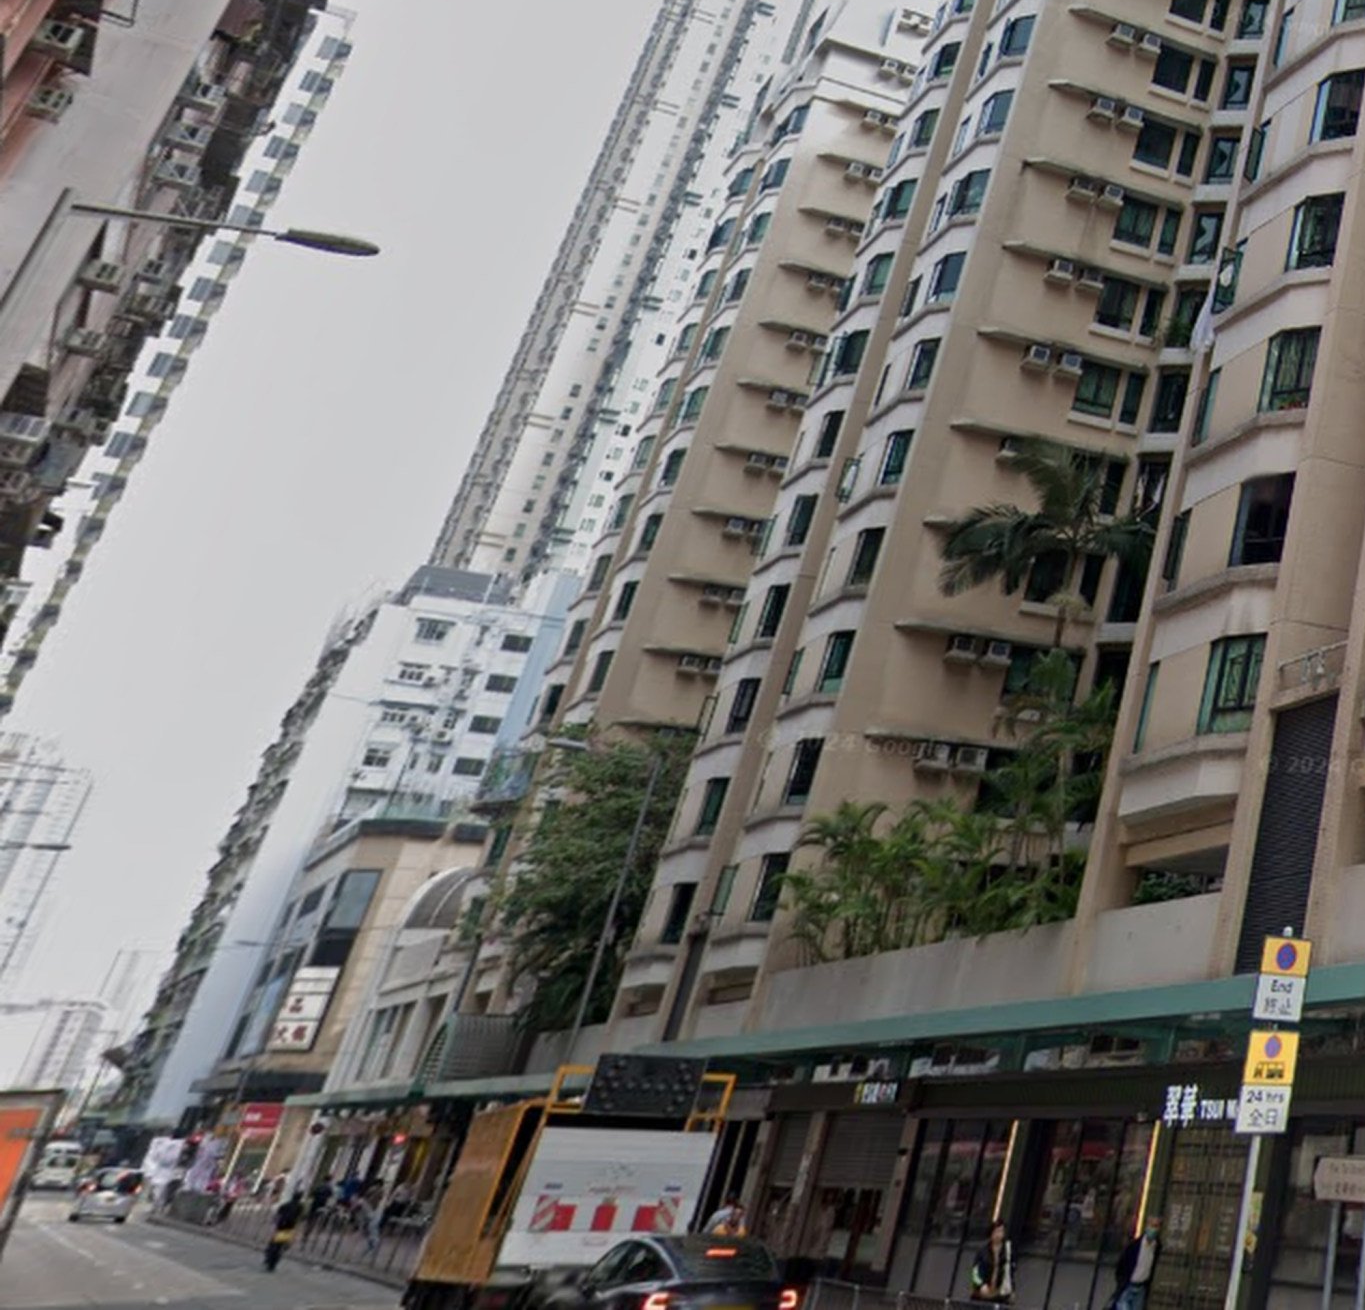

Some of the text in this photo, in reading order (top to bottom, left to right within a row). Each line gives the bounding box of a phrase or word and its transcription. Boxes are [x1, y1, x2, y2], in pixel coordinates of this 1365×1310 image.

[1270, 979, 1294, 994] End
[1246, 1090, 1285, 1104] 24 hrs
[1247, 1108, 1278, 1127] 全日
